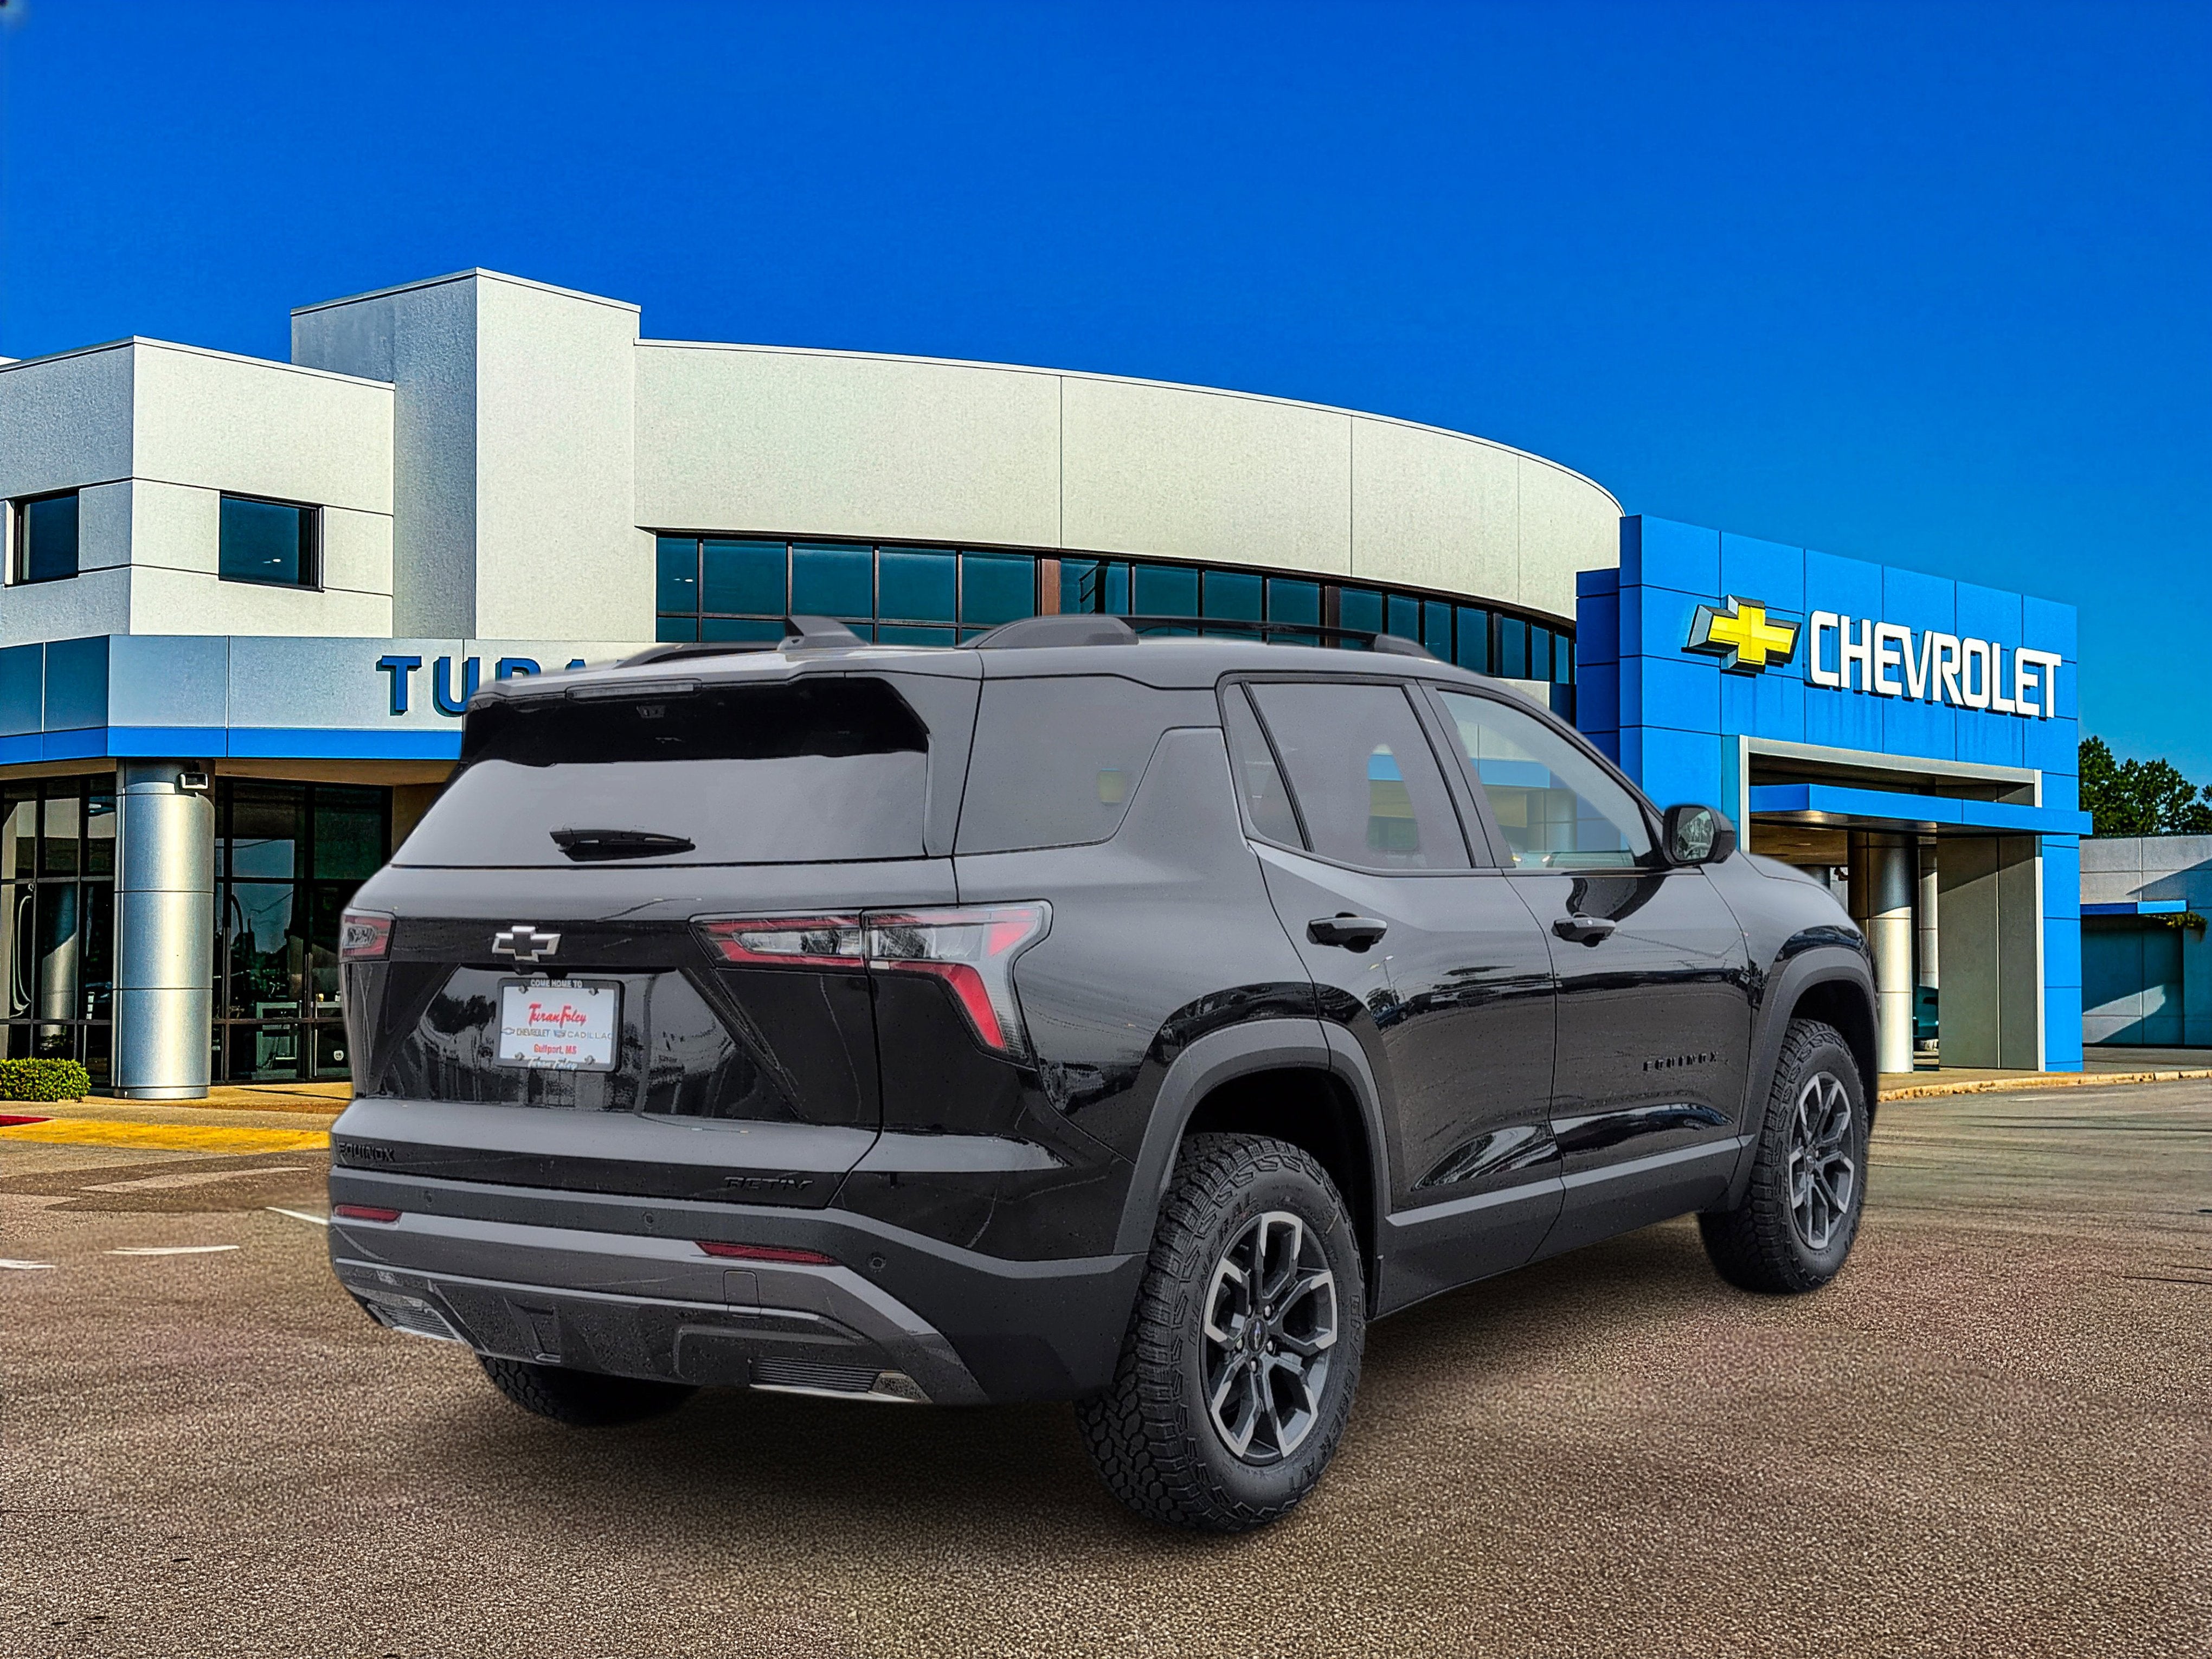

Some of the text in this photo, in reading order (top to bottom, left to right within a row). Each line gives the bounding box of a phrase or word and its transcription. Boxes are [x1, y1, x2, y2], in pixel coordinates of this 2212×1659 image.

[1810, 610, 2062, 718] CHEVROLET
[516, 1028, 550, 1037] CHEVROLET
[565, 1045, 577, 1054] MS
[338, 1142, 396, 1162] EQUINOX
